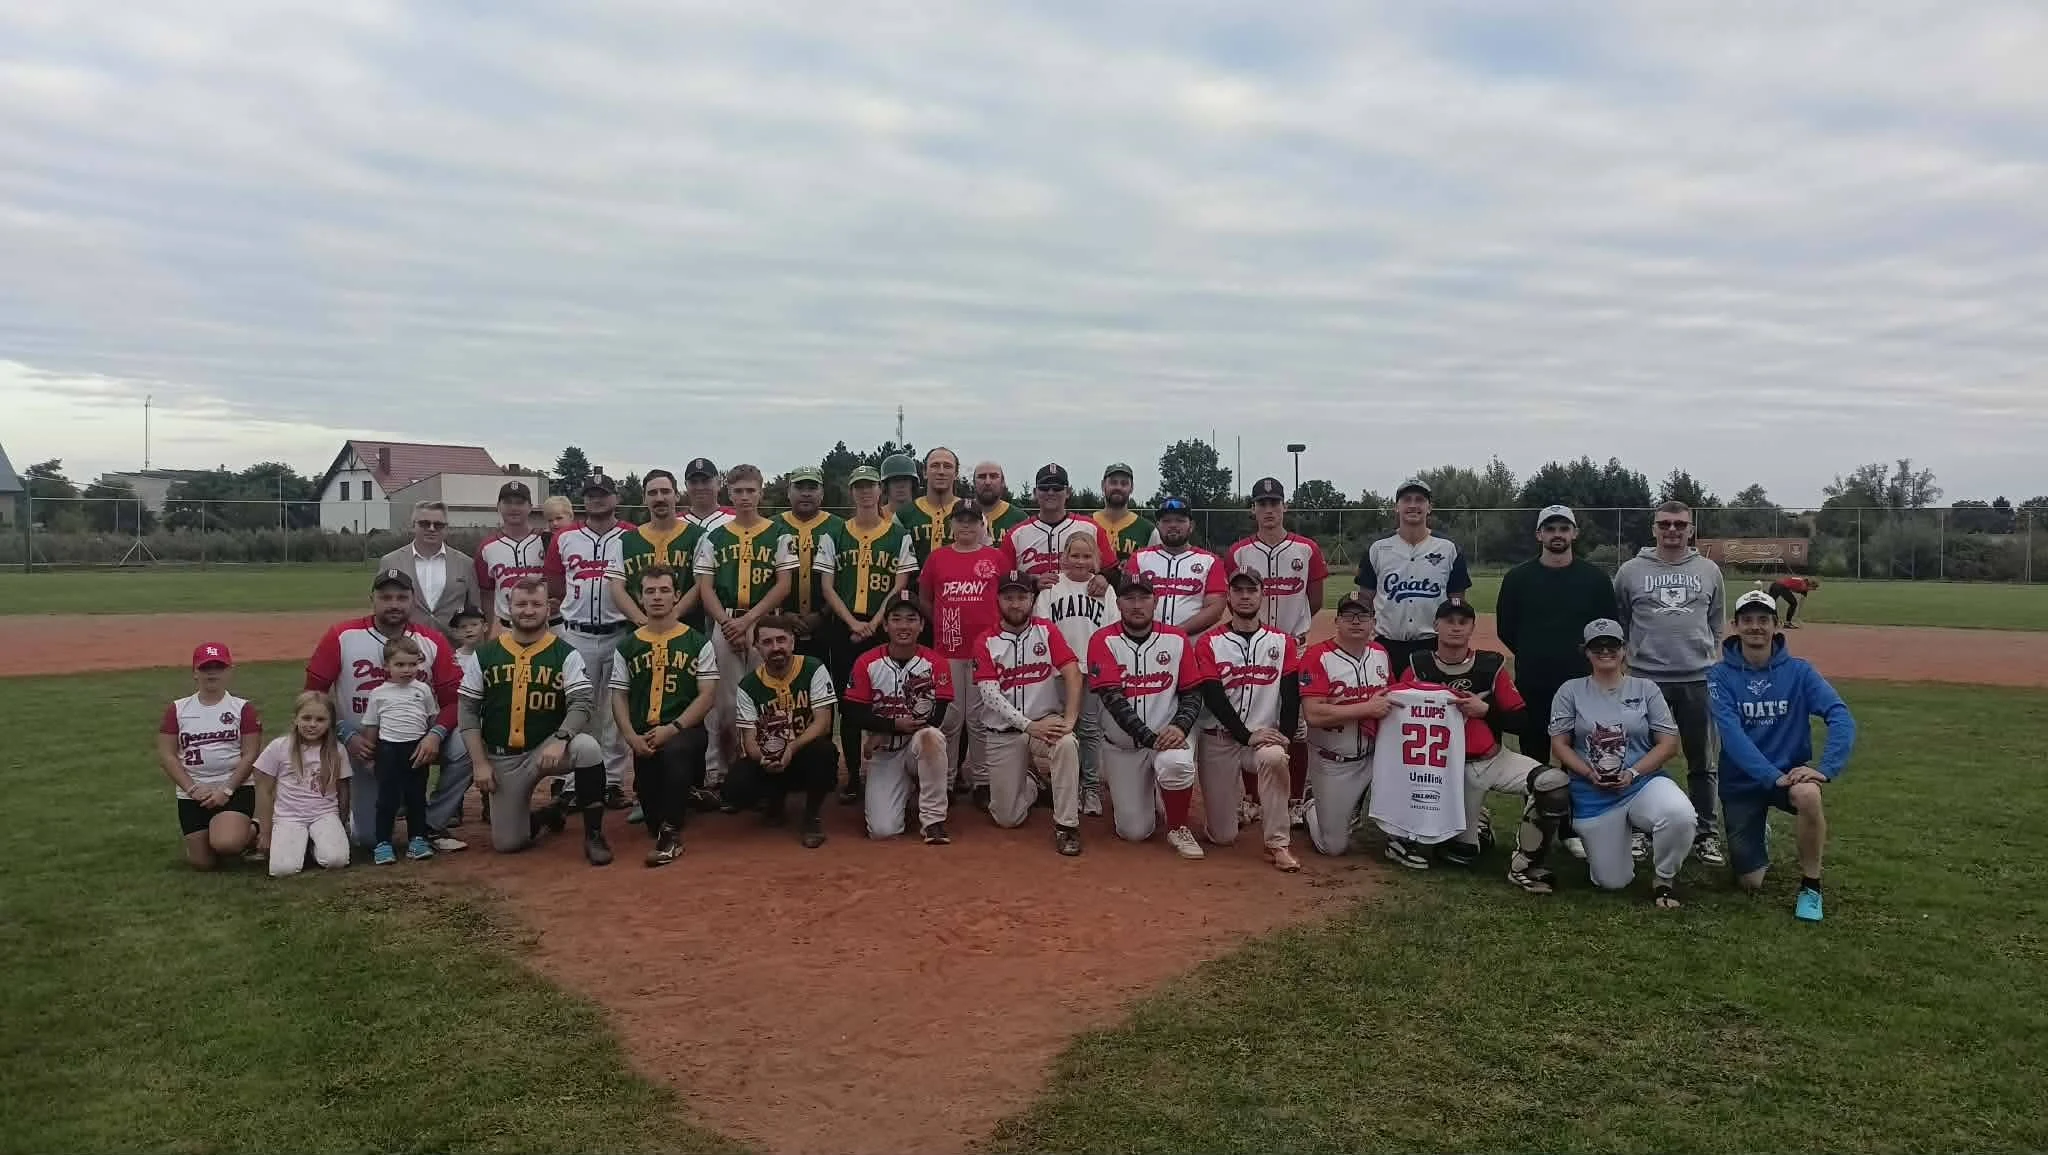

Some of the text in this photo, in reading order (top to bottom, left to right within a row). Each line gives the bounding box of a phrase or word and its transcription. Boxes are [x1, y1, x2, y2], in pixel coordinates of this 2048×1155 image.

[624, 549, 691, 576] TITAN
[870, 573, 890, 592] 89
[942, 580, 988, 597] DEMONY
[1384, 572, 1441, 603] Goats
[1644, 573, 1702, 593] DODGERS
[1051, 594, 1105, 627] MAINE
[665, 674, 677, 693] 5
[529, 691, 556, 710] 00
[1737, 700, 1788, 718] OAT'S
[1402, 723, 1450, 768] 22
[184, 749, 204, 766] 21
